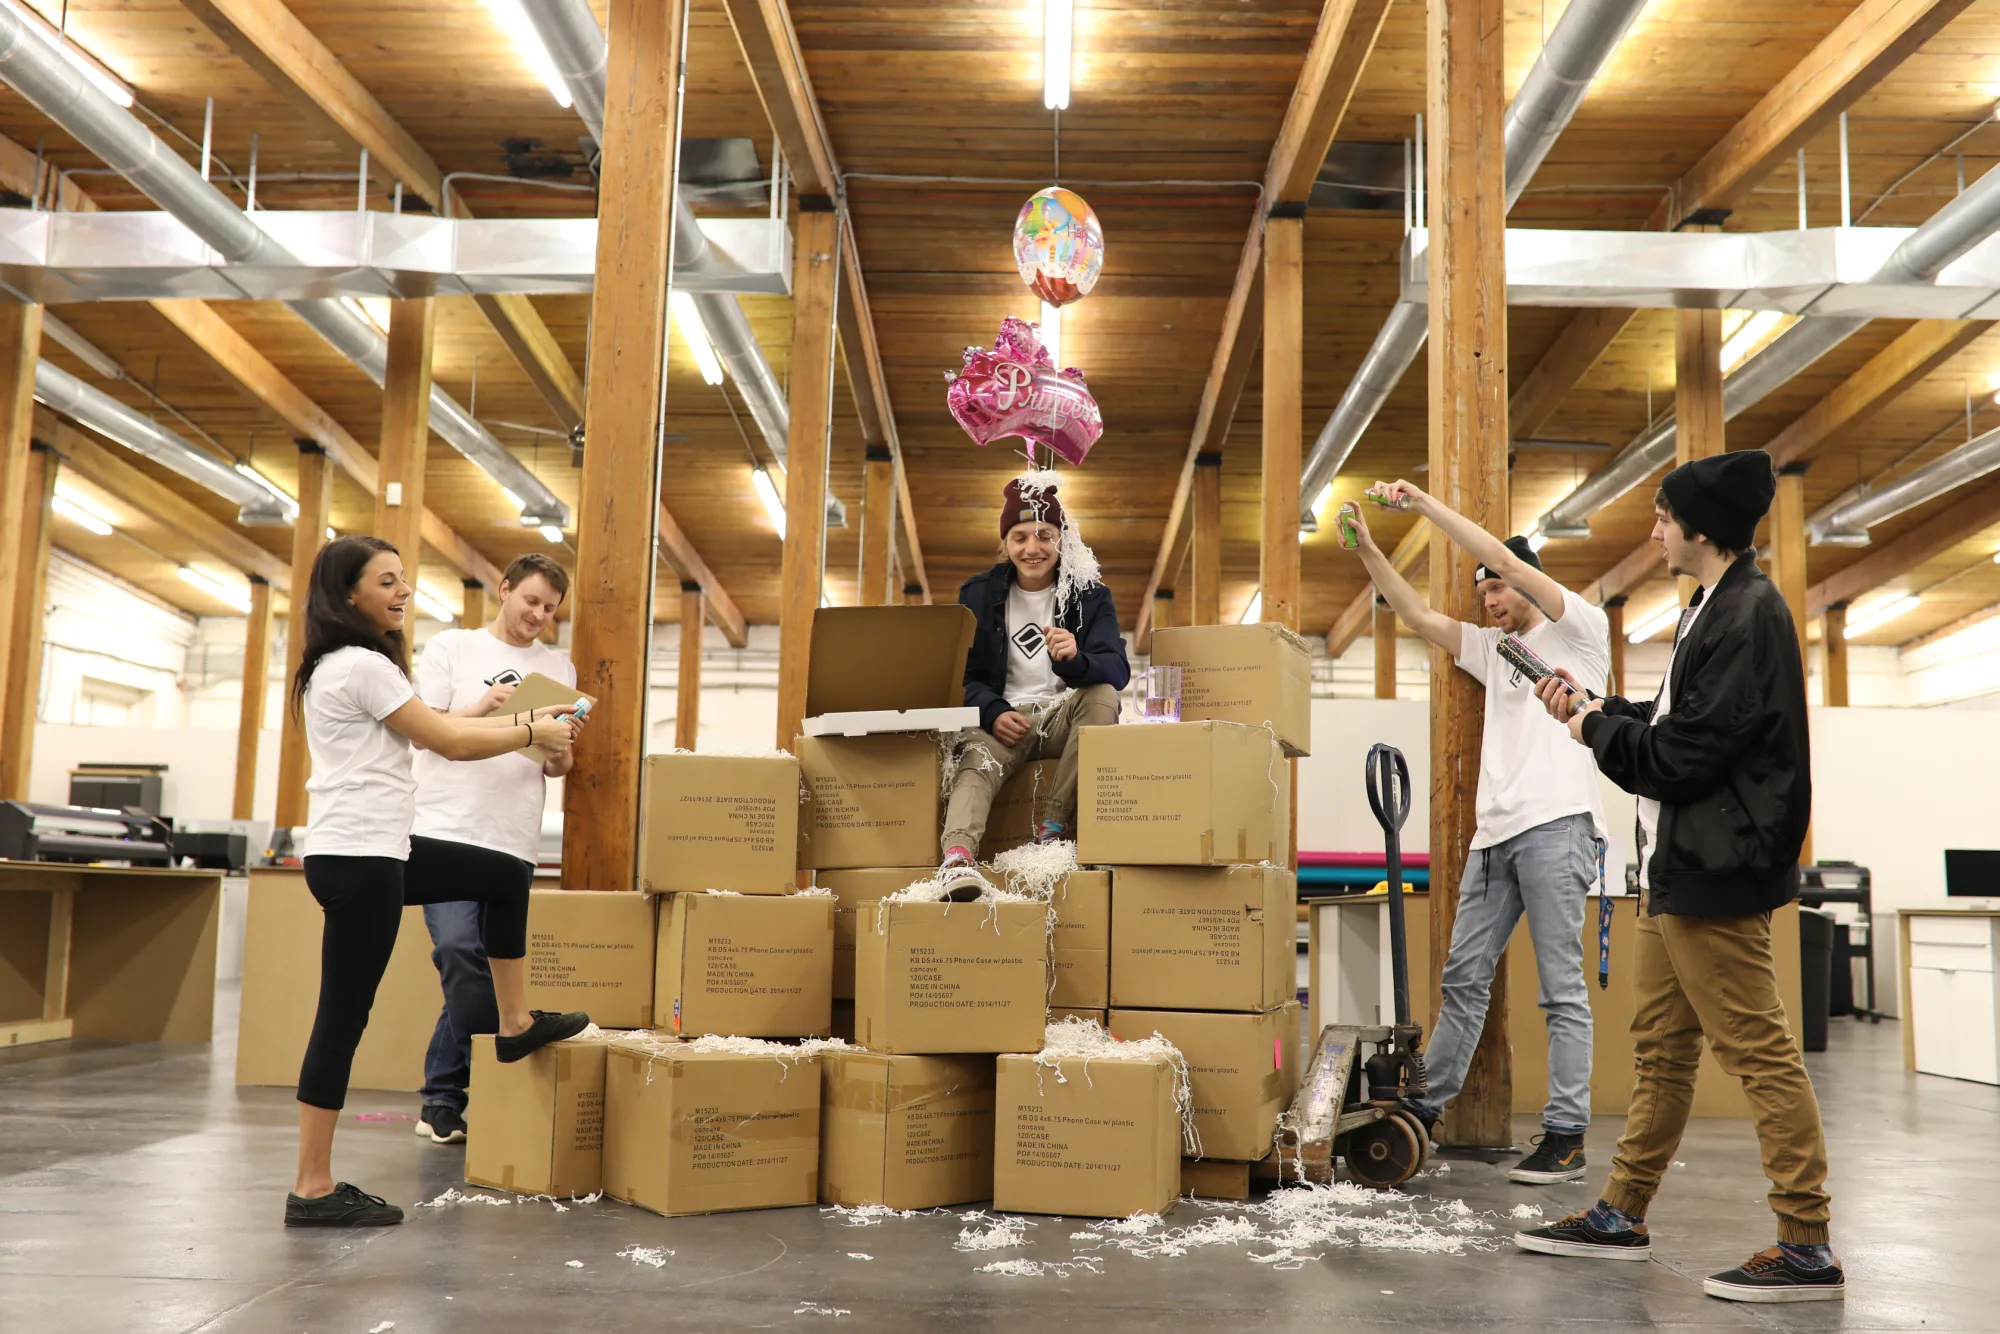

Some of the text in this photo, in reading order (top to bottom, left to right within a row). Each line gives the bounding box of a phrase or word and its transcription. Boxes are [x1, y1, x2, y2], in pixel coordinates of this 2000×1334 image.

[994, 362, 1100, 427] Princess
[693, 1161, 736, 1169] PRODUCTION
[1017, 1159, 1062, 1167] PRODUCTION
[1086, 1163, 1120, 1171] 2014/11/27
